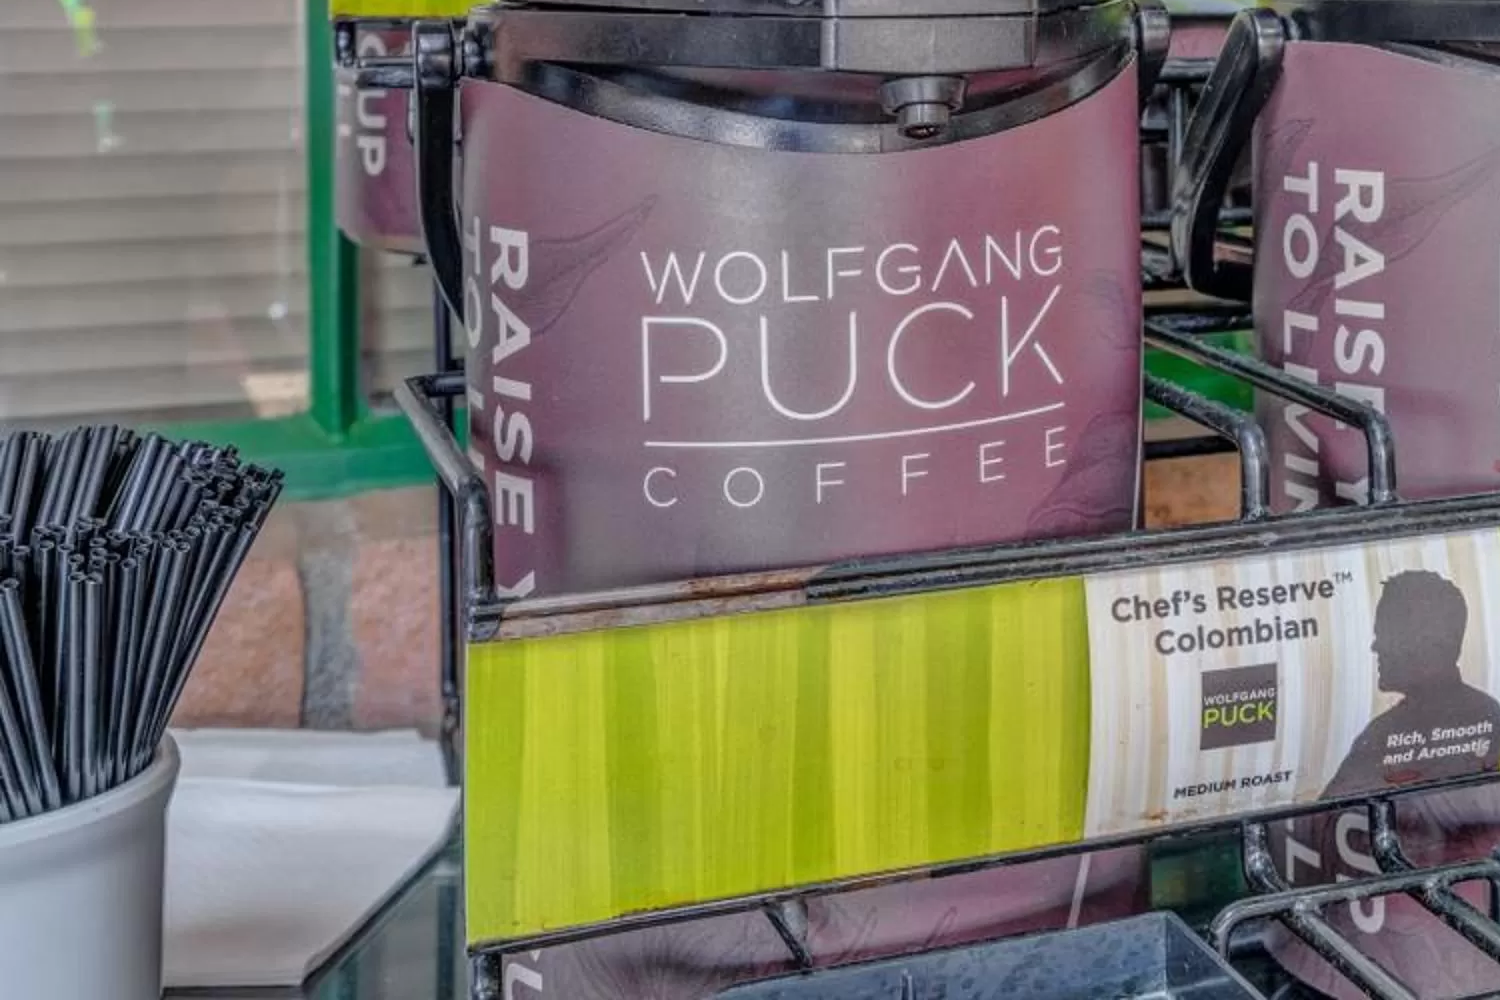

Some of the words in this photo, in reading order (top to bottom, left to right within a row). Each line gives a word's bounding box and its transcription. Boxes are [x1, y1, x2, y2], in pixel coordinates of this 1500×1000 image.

[1283, 160, 1319, 279] TO
[640, 224, 1064, 306] WOLFGANG
[641, 284, 1065, 422] PUCK
[489, 225, 536, 535] RAISE
[642, 425, 1066, 509] COFFEE
[1111, 587, 1208, 624] Chef's
[1155, 616, 1319, 656] Colombian
[1202, 701, 1274, 729] PUCK
[1203, 687, 1276, 706] WOLFGANG
[1382, 748, 1415, 766] and
[1417, 738, 1492, 760] Aromatic
[1386, 730, 1427, 749] Rich,
[1430, 719, 1493, 741] Smooth
[1173, 778, 1237, 800] MEDIUM
[1240, 769, 1293, 789] ROAST
